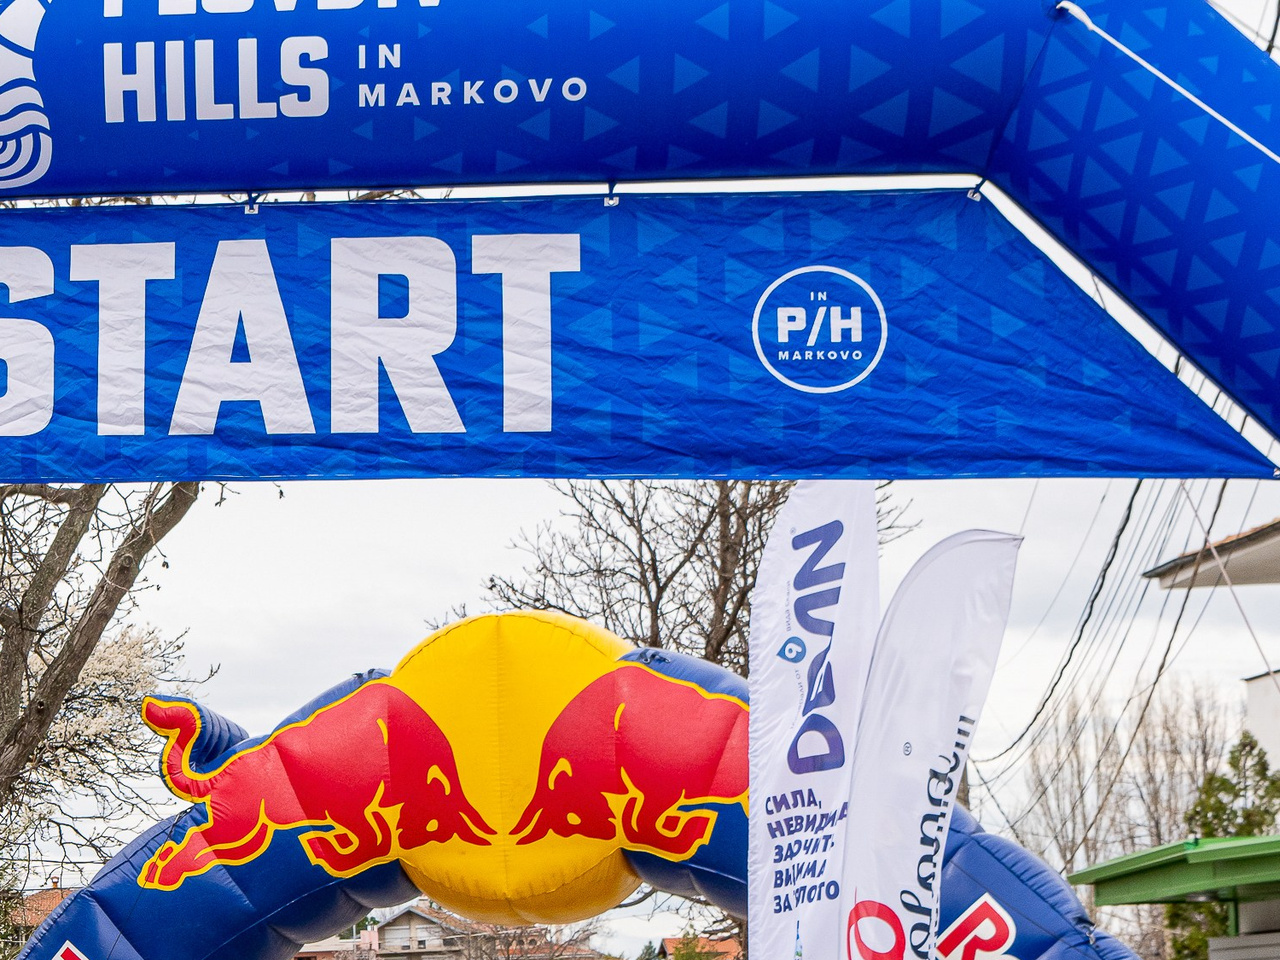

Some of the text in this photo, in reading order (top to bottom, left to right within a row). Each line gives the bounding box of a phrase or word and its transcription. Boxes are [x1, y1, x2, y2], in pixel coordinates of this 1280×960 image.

[358, 43, 401, 69] IN
[103, 36, 330, 123] HILLS
[358, 76, 588, 108] MARKOVO
[810, 291, 827, 301] IN
[777, 306, 862, 347] P/H
[778, 350, 863, 361] MARKOVO
